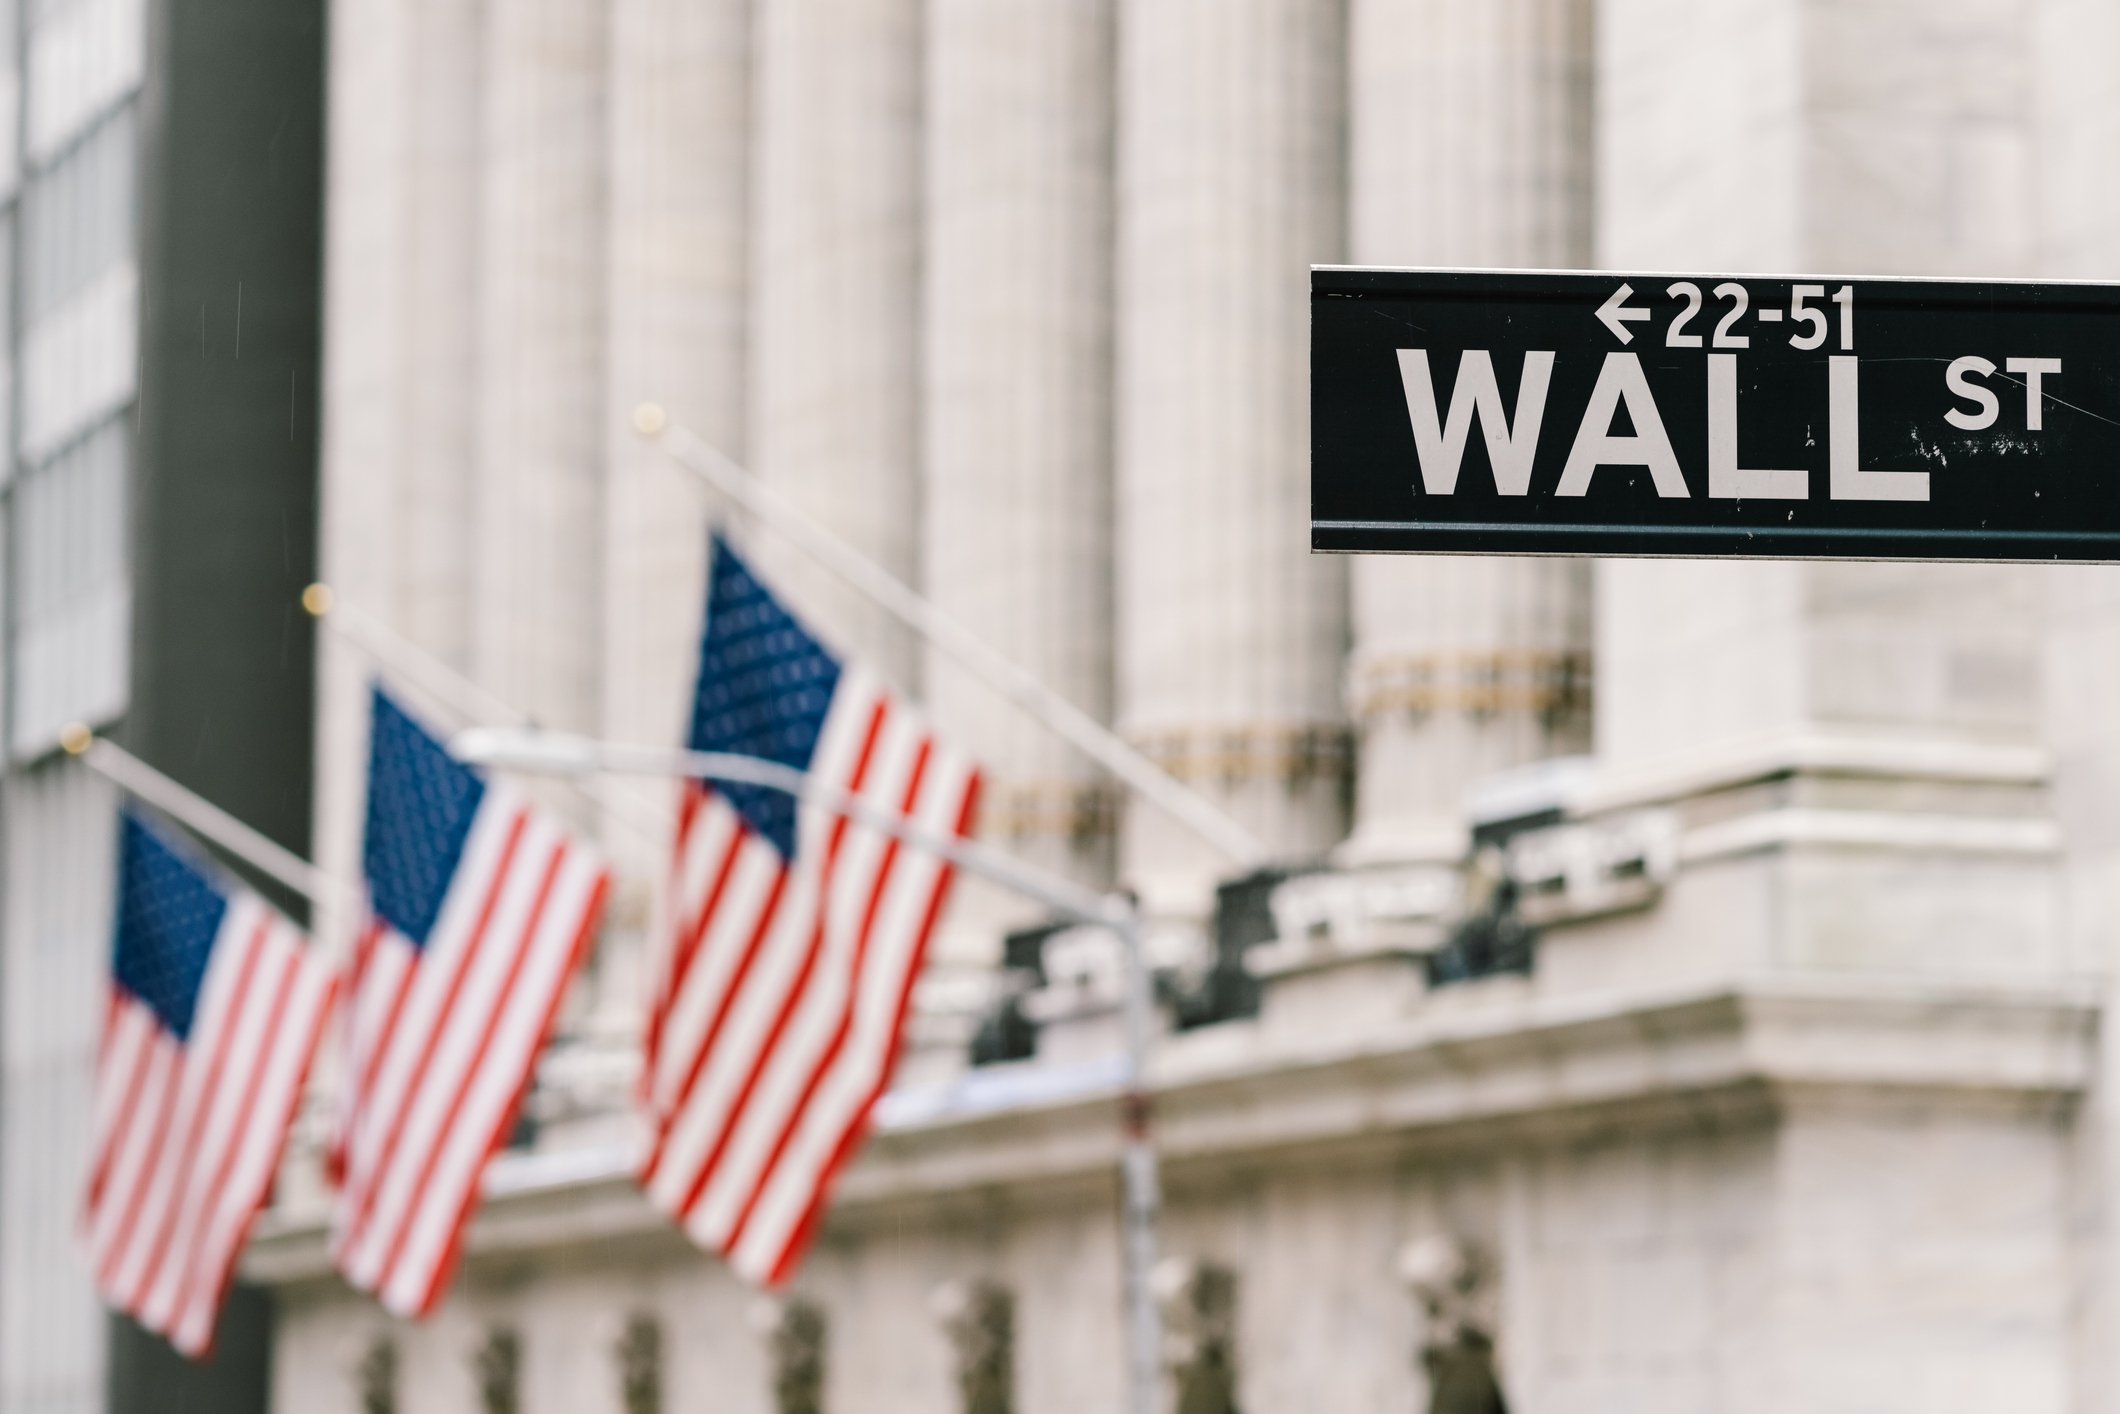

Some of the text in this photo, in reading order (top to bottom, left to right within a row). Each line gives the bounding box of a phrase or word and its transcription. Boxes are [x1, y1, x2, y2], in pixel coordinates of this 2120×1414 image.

[1666, 282, 1854, 350] 22-51
[1396, 349, 2062, 501] WALL ST
